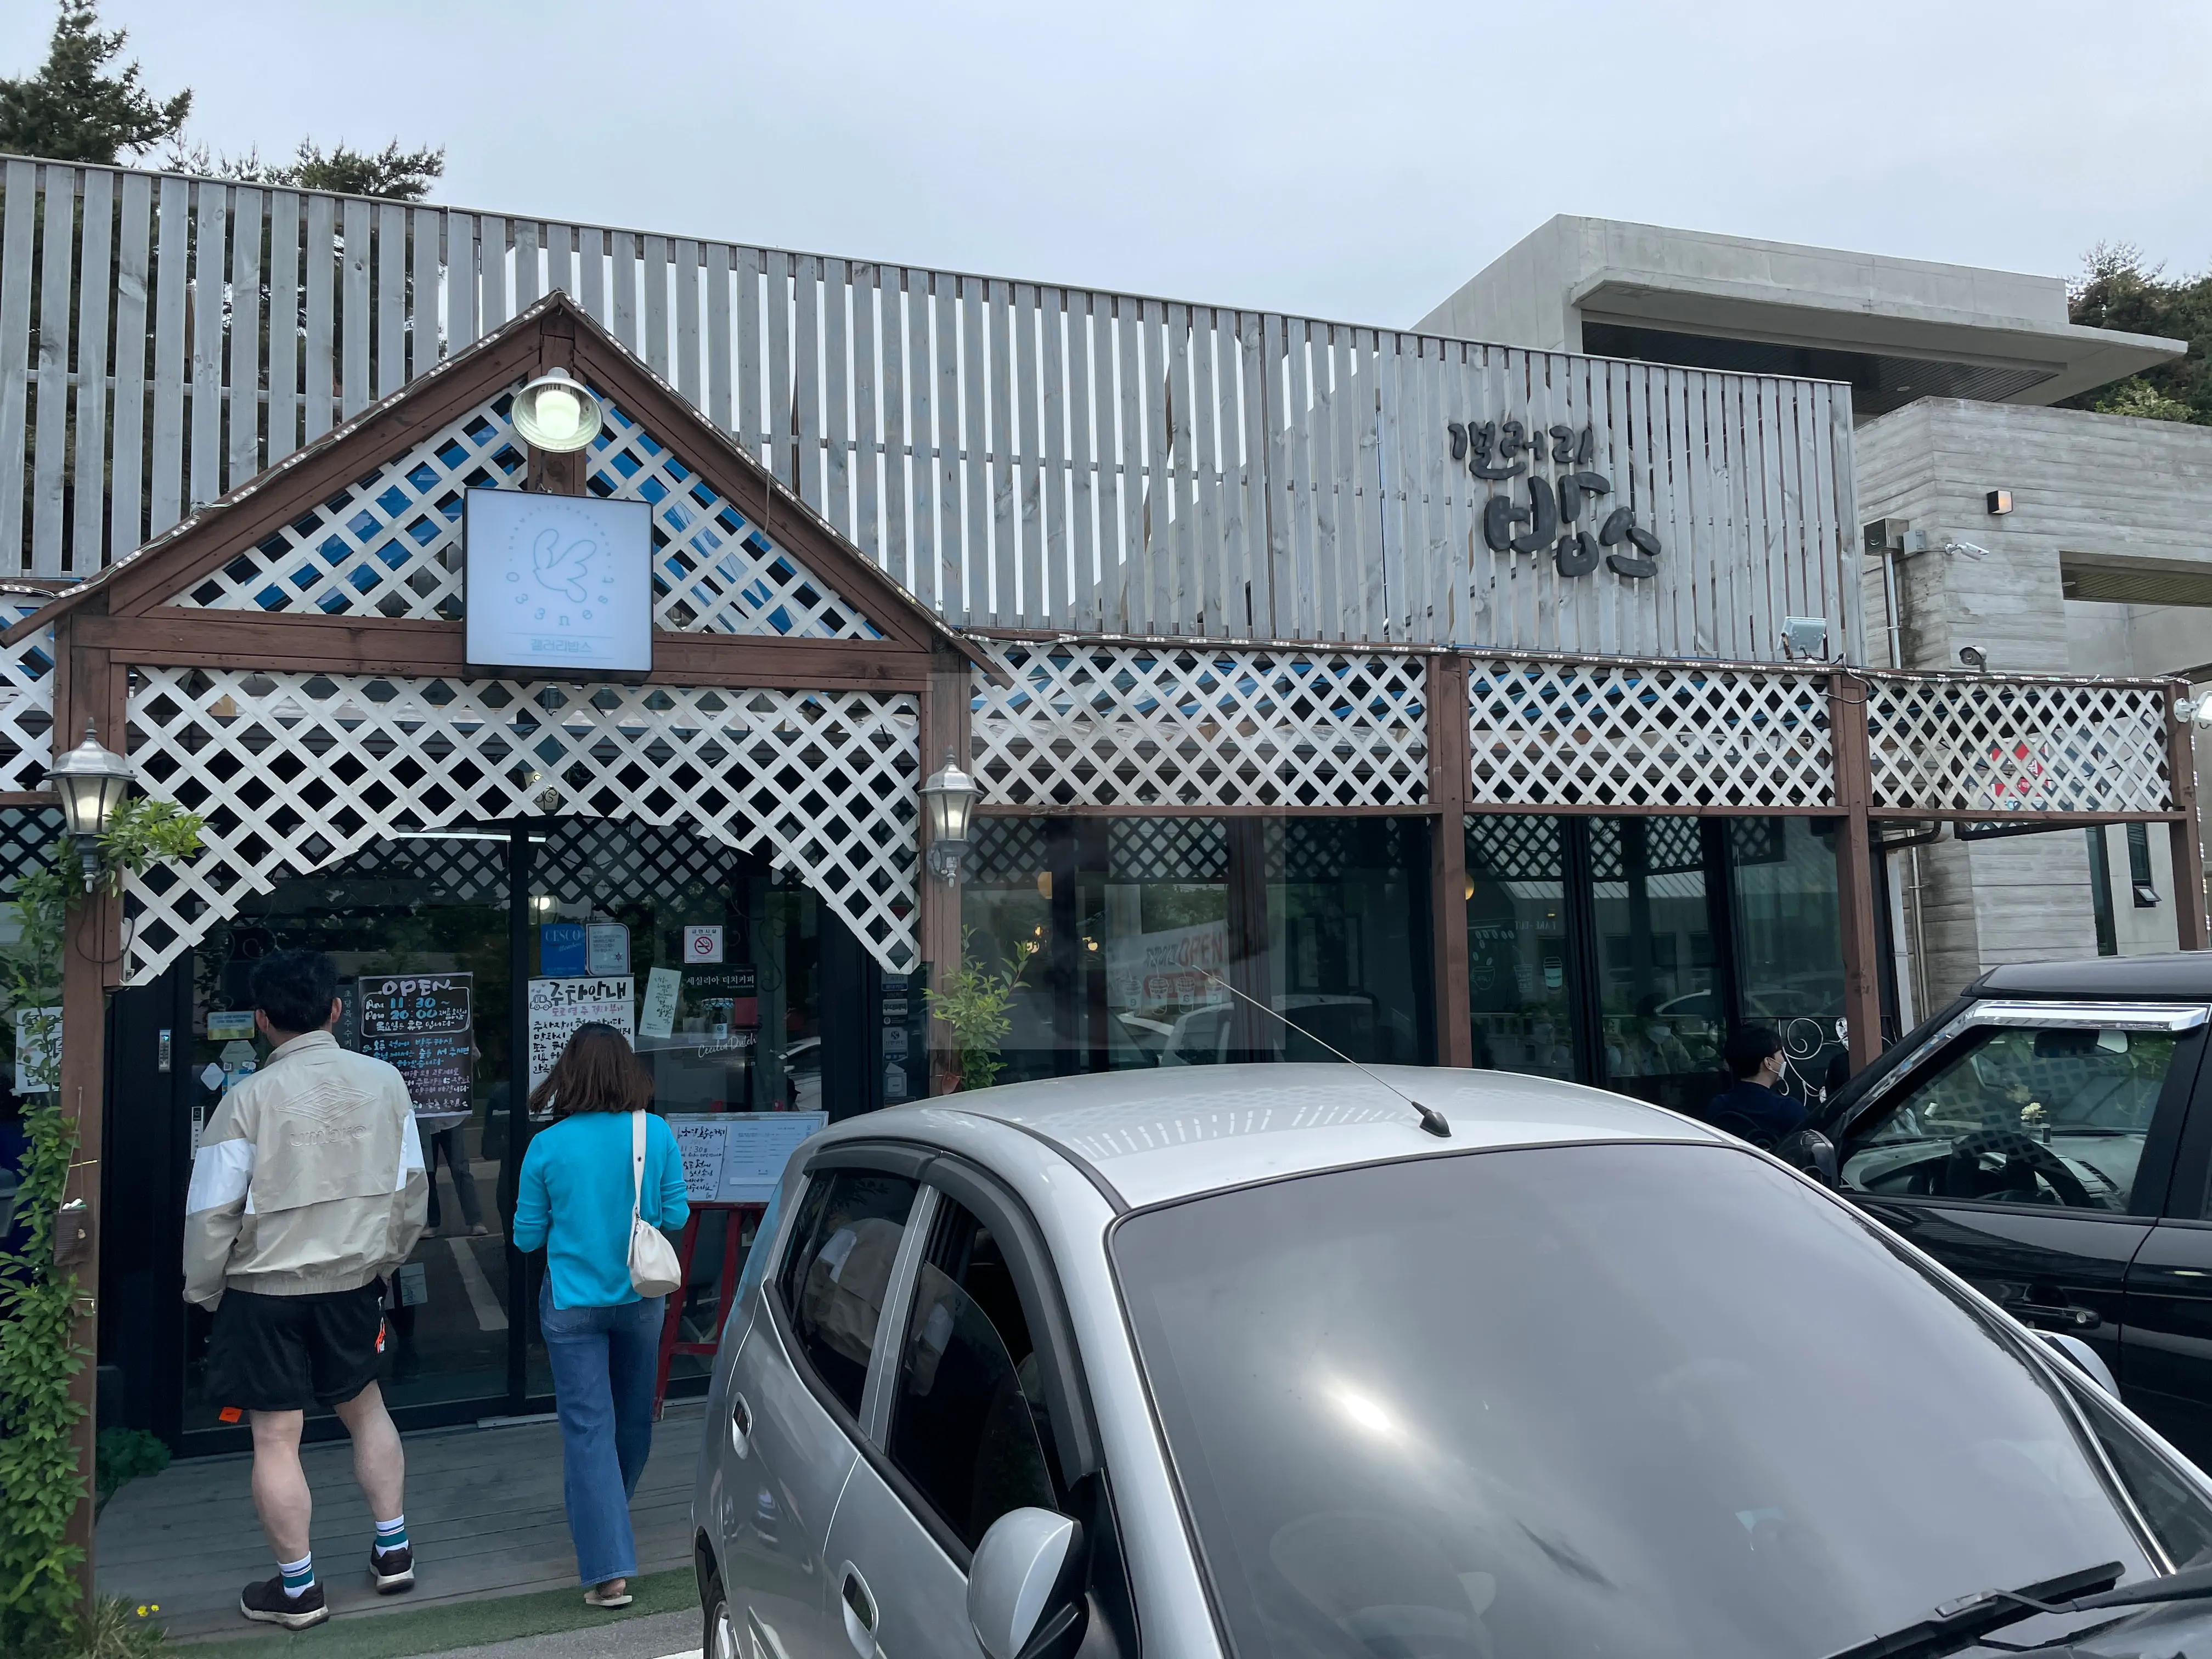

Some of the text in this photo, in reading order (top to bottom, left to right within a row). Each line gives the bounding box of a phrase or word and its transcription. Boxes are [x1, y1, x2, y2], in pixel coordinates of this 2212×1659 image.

[531, 638, 592, 653] 갤러리밥스
[545, 929, 580, 941] CESCO
[382, 979, 451, 996] OPEN
[686, 975, 754, 985] 세실리아 더치커피
[550, 981, 626, 1006] 주차안내
[376, 1020, 455, 1032] 목요일은 휴무 입니다
[290, 1125, 367, 1147] umbro
